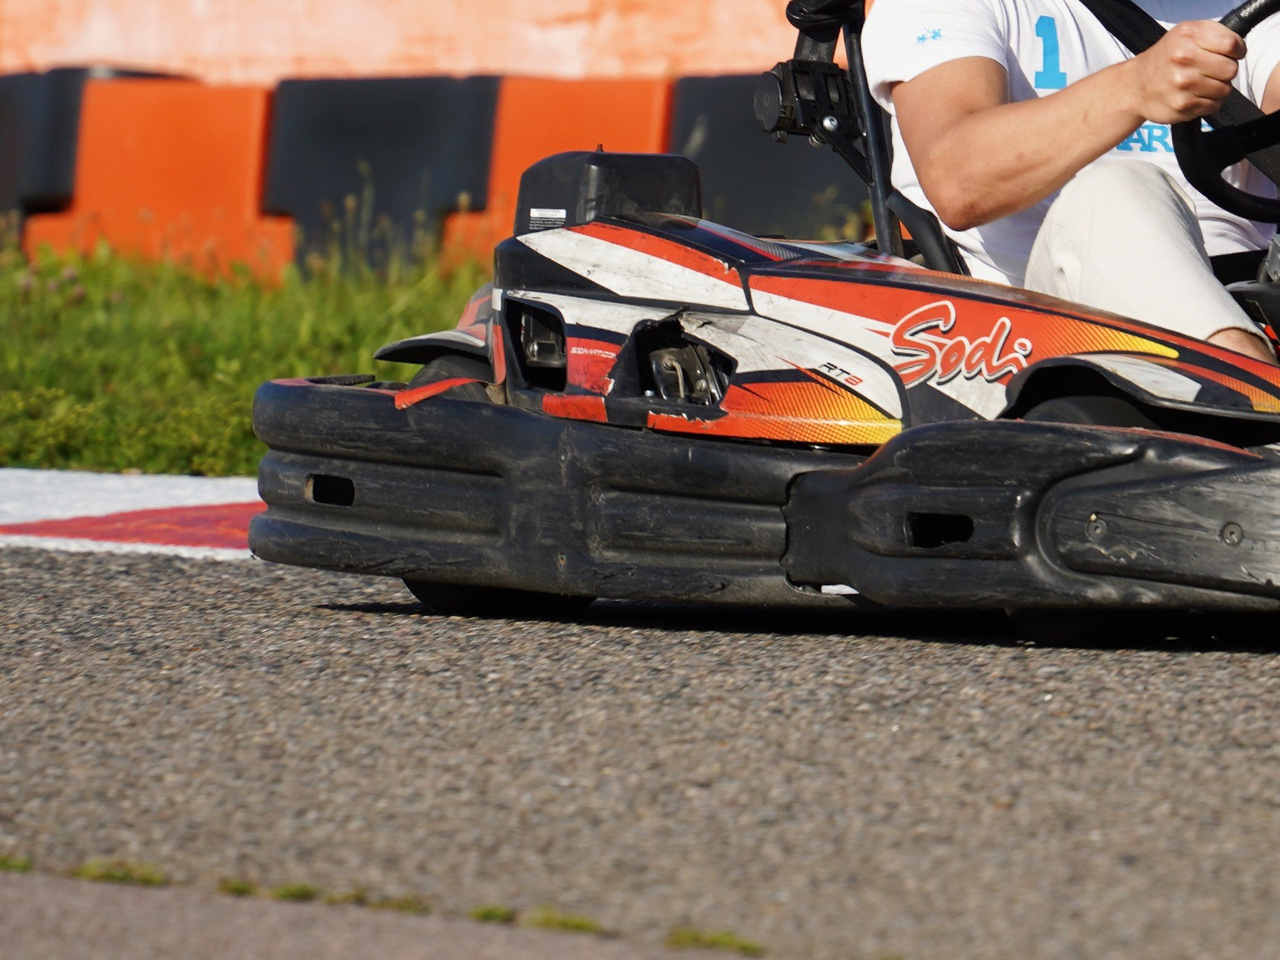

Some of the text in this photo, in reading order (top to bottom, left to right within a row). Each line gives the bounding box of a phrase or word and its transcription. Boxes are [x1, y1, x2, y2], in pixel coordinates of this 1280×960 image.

[1034, 15, 1067, 89] 1
[819, 362, 863, 386] RT8
[891, 300, 1033, 389] Sodi
